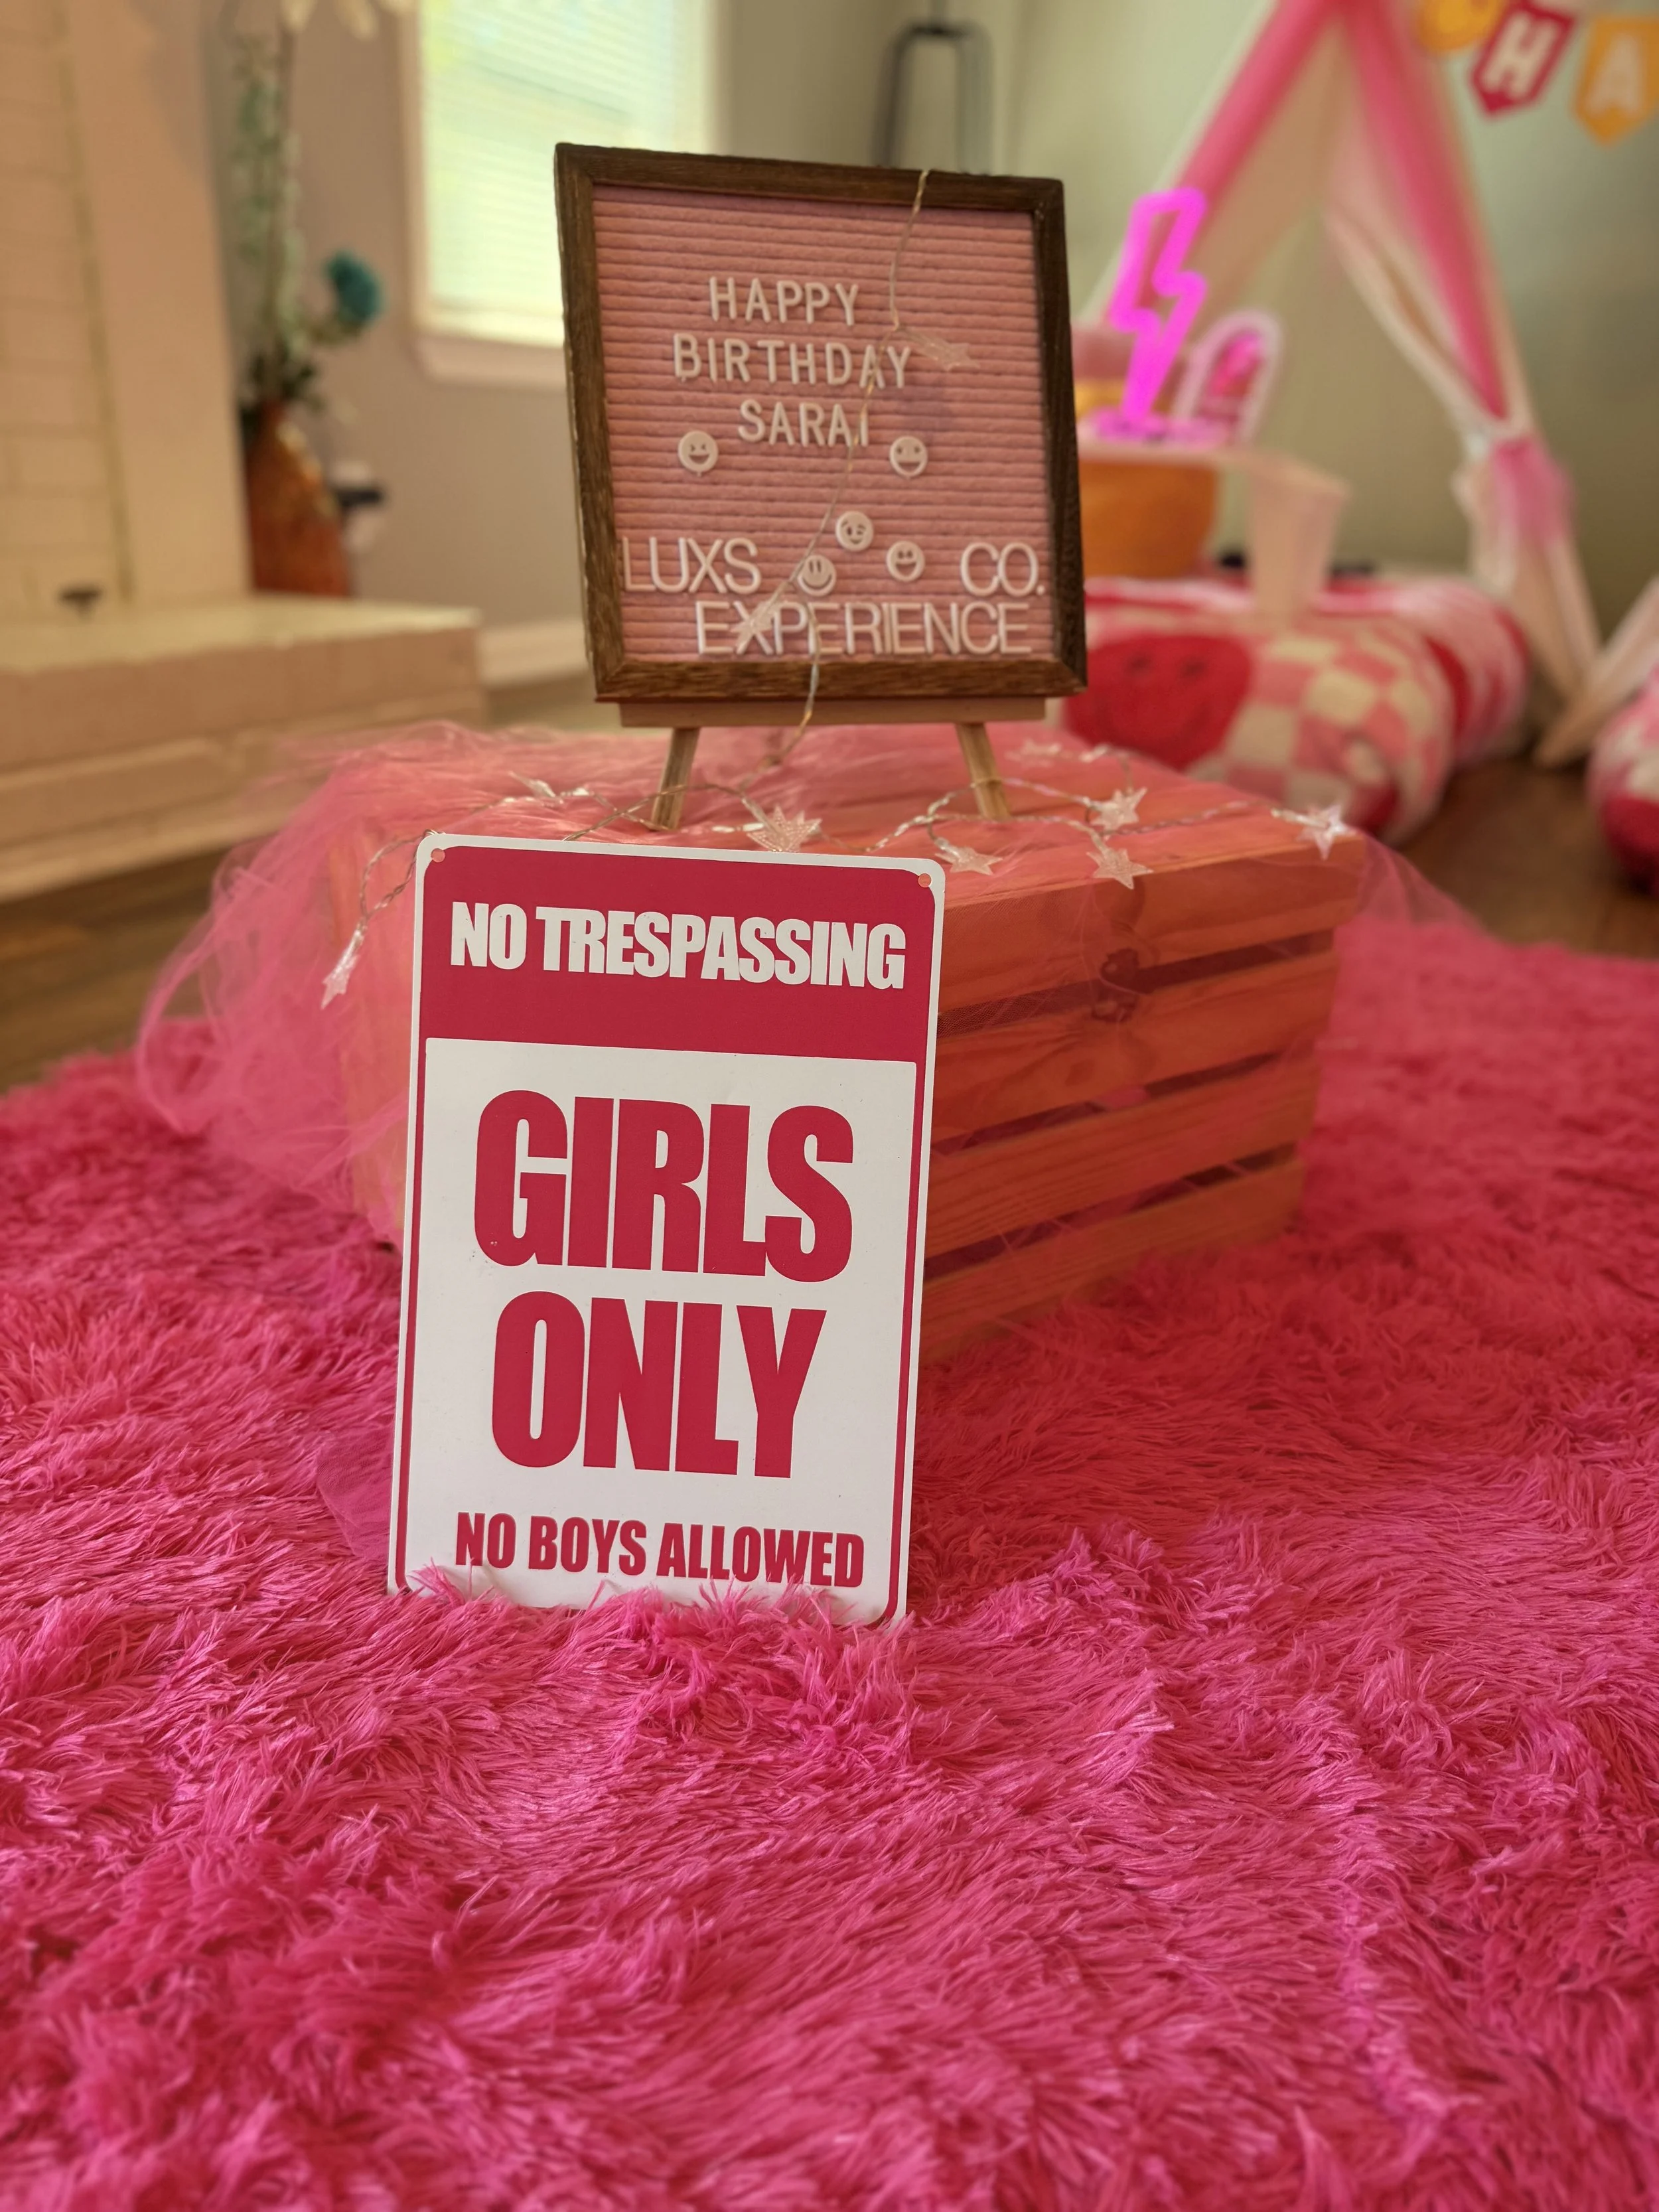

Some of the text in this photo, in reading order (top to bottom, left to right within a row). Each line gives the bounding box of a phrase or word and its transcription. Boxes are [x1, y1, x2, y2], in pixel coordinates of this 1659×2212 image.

[709, 276, 859, 326] HAPPY
[673, 332, 911, 389] BIRTHDAY
[737, 399, 869, 448] SARAI
[622, 536, 1046, 597] LUXS CO.
[695, 600, 1032, 656] EXPERIENCE
[450, 901, 906, 990] NO TRESPASSING
[474, 1089, 854, 1284] GIRLS
[490, 1290, 827, 1479] ONLY
[455, 1511, 865, 1588] NO BOYS ALLOWED
